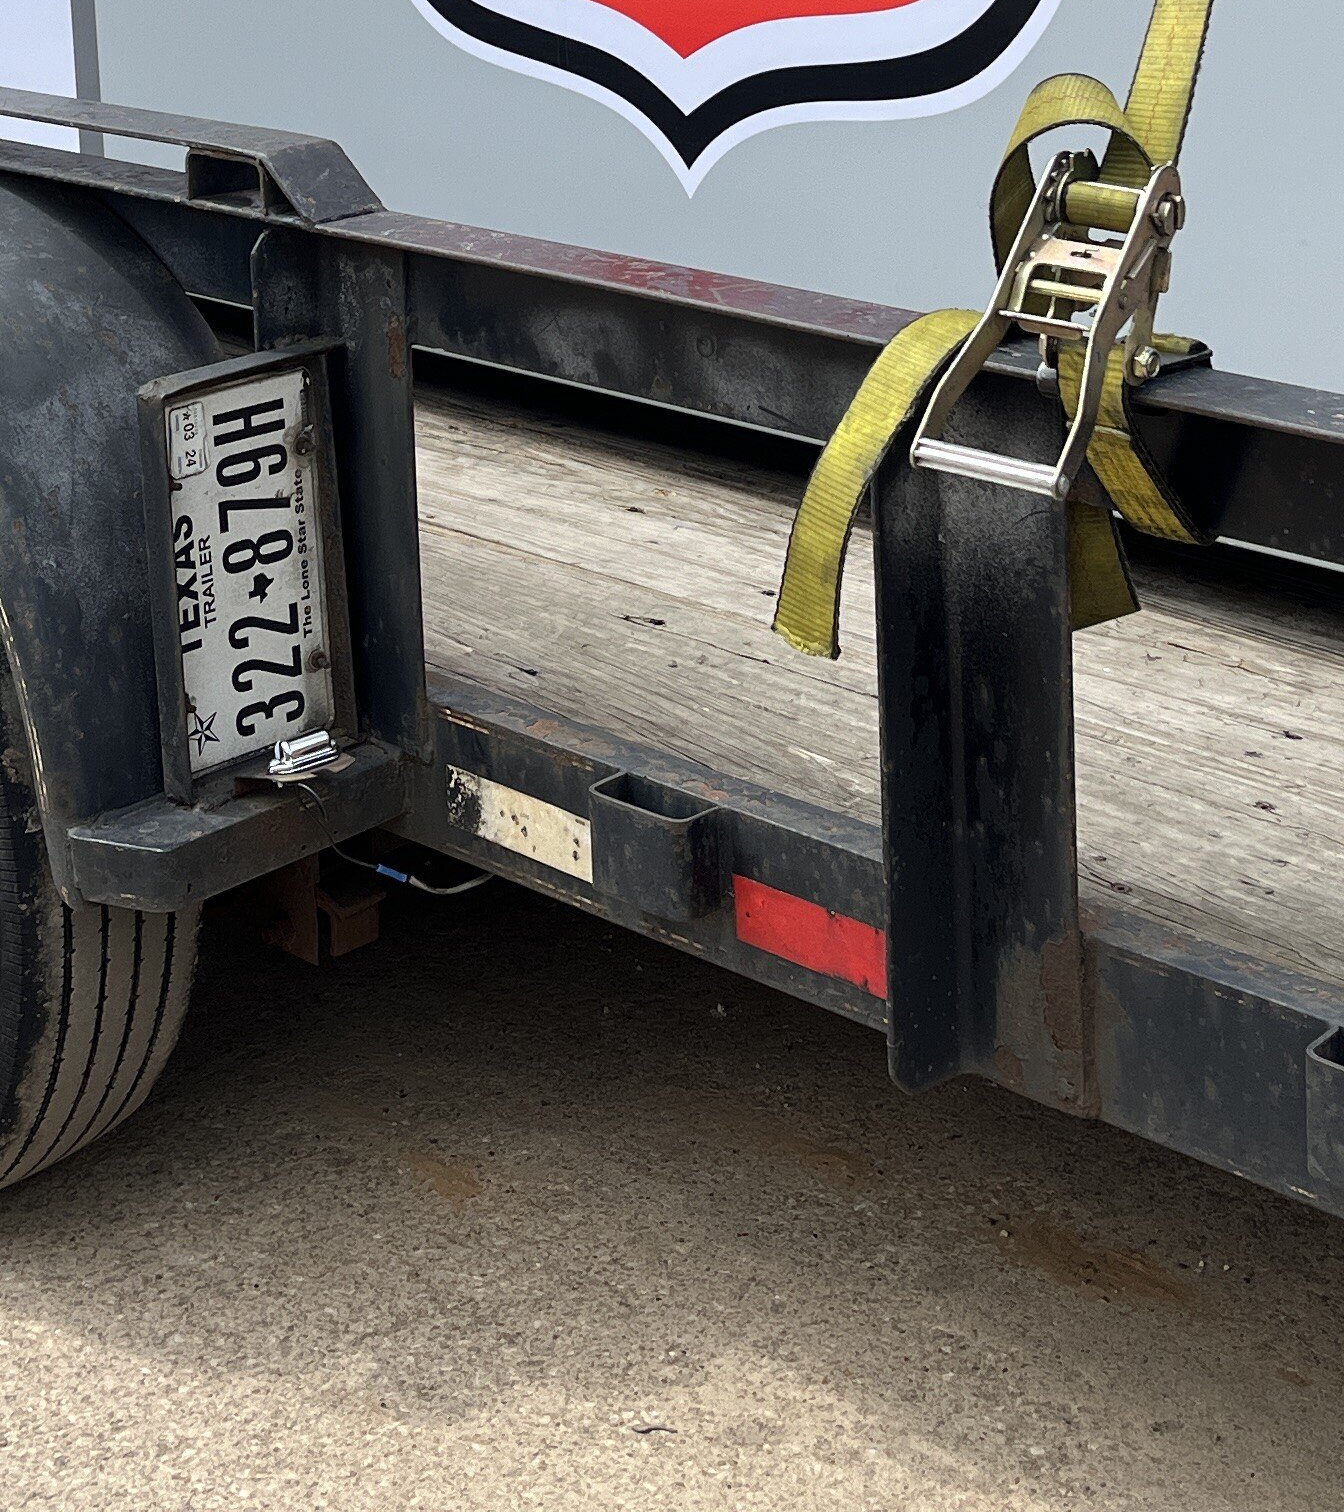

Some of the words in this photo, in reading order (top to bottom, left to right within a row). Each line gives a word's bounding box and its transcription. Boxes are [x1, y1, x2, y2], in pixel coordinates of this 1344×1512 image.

[184, 423, 195, 441] 03
[186, 450, 196, 467] 24
[294, 469, 304, 514] State
[298, 519, 307, 554] Star
[173, 515, 203, 654] TEXAS
[198, 535, 217, 629] TRAILER
[301, 559, 311, 600] Lone
[303, 605, 312, 639] The
